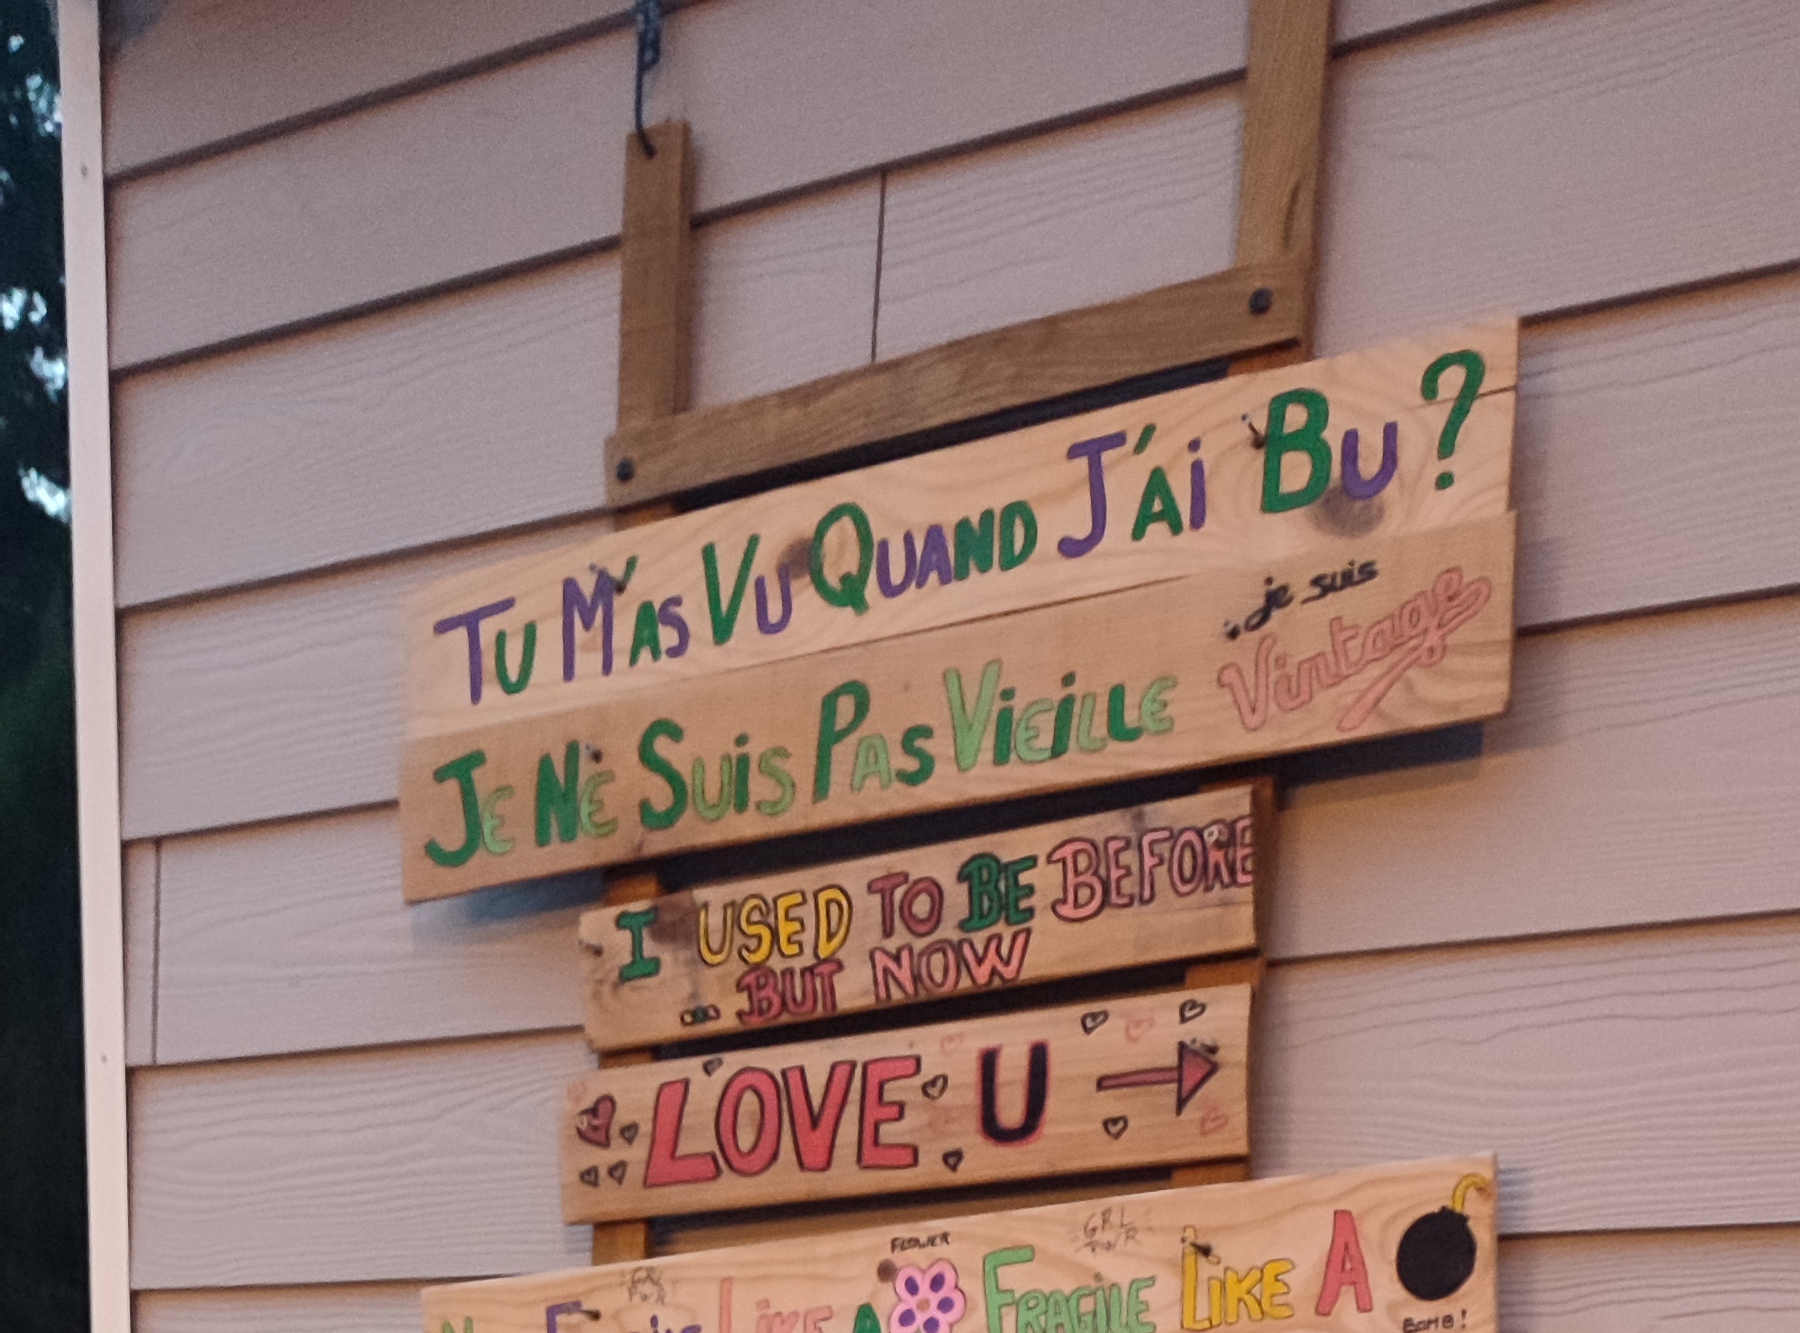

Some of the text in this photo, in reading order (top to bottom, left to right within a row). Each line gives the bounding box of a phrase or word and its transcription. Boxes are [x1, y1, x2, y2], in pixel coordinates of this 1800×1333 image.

[809, 501, 1037, 615] QUAND
[1300, 560, 1379, 605] suis
[1218, 567, 1492, 732] Vintage
[616, 814, 1254, 981] I USED TO BE BEFORE
[870, 927, 1030, 1000] NOW
[644, 1040, 1050, 1189] LOVE U
[1315, 1209, 1373, 1316] A
